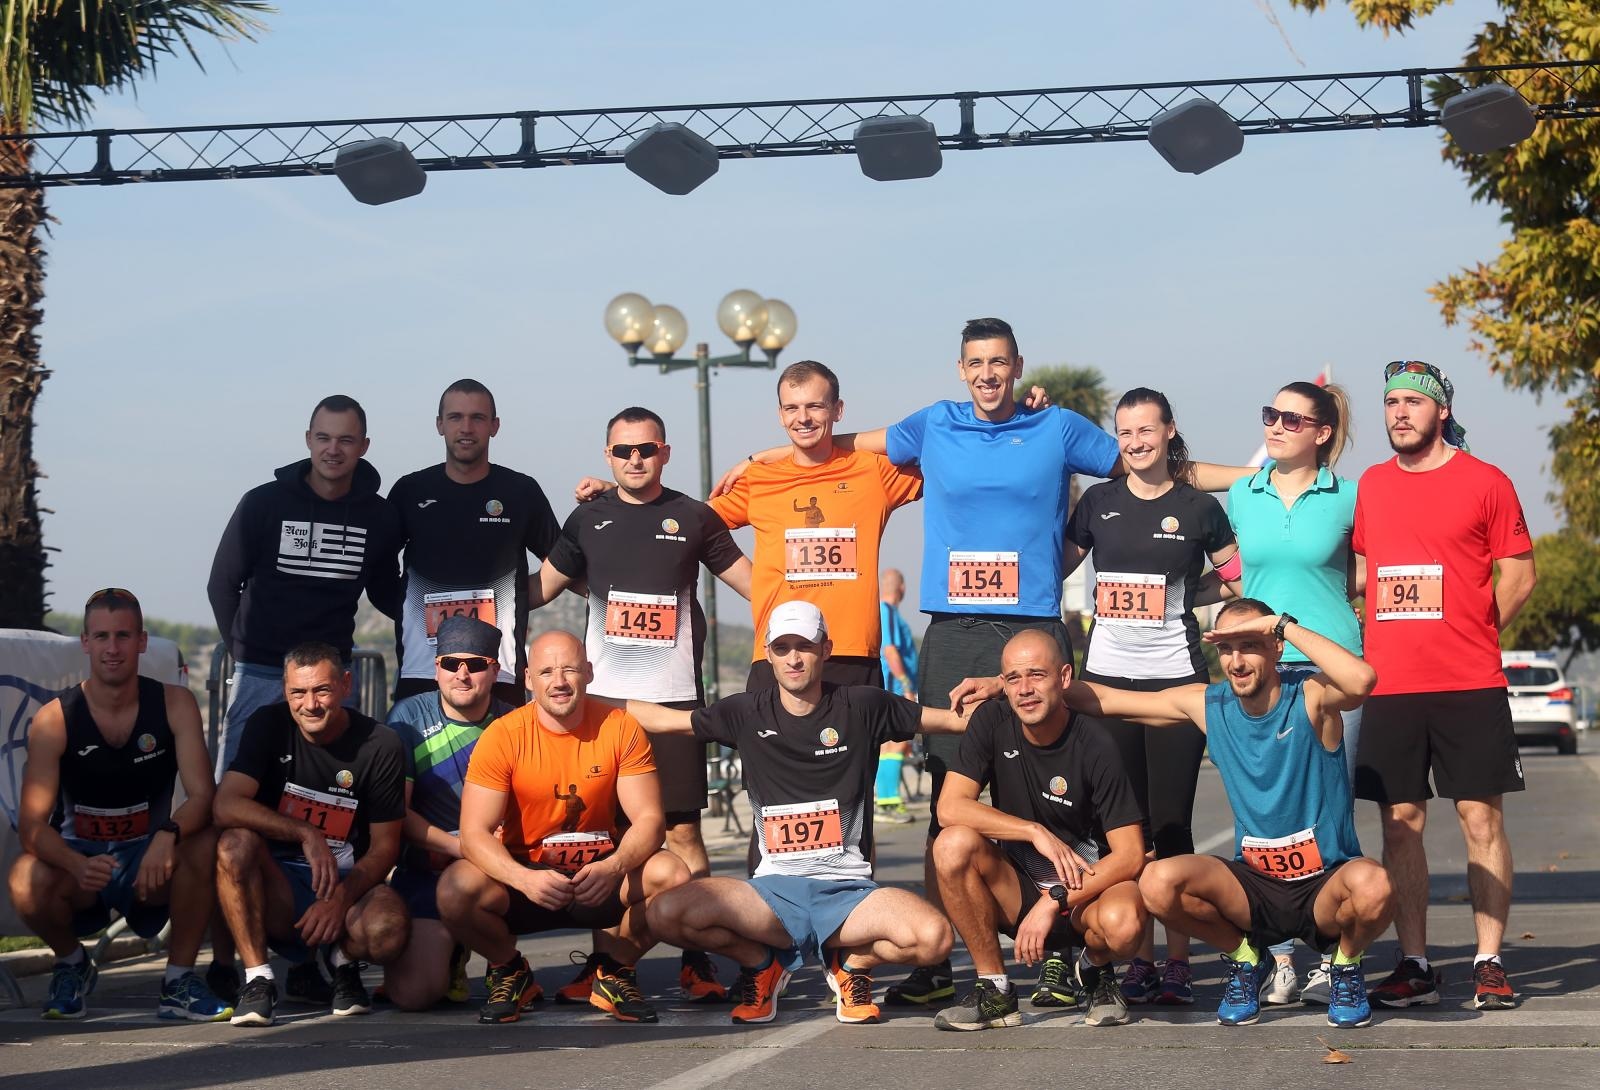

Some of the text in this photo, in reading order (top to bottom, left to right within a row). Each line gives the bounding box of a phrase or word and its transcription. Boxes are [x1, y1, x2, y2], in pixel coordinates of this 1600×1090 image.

[284, 525, 308, 537] New
[293, 538, 318, 549] Yok
[800, 545, 842, 566] 136
[961, 569, 1003, 590] 154
[1109, 590, 1149, 612] 131
[1393, 583, 1420, 605] 94
[620, 610, 662, 632] 145
[90, 819, 134, 837] 132
[303, 807, 329, 831] 11
[780, 820, 824, 845] 197
[555, 847, 601, 867] 147
[1258, 851, 1305, 873] 130
